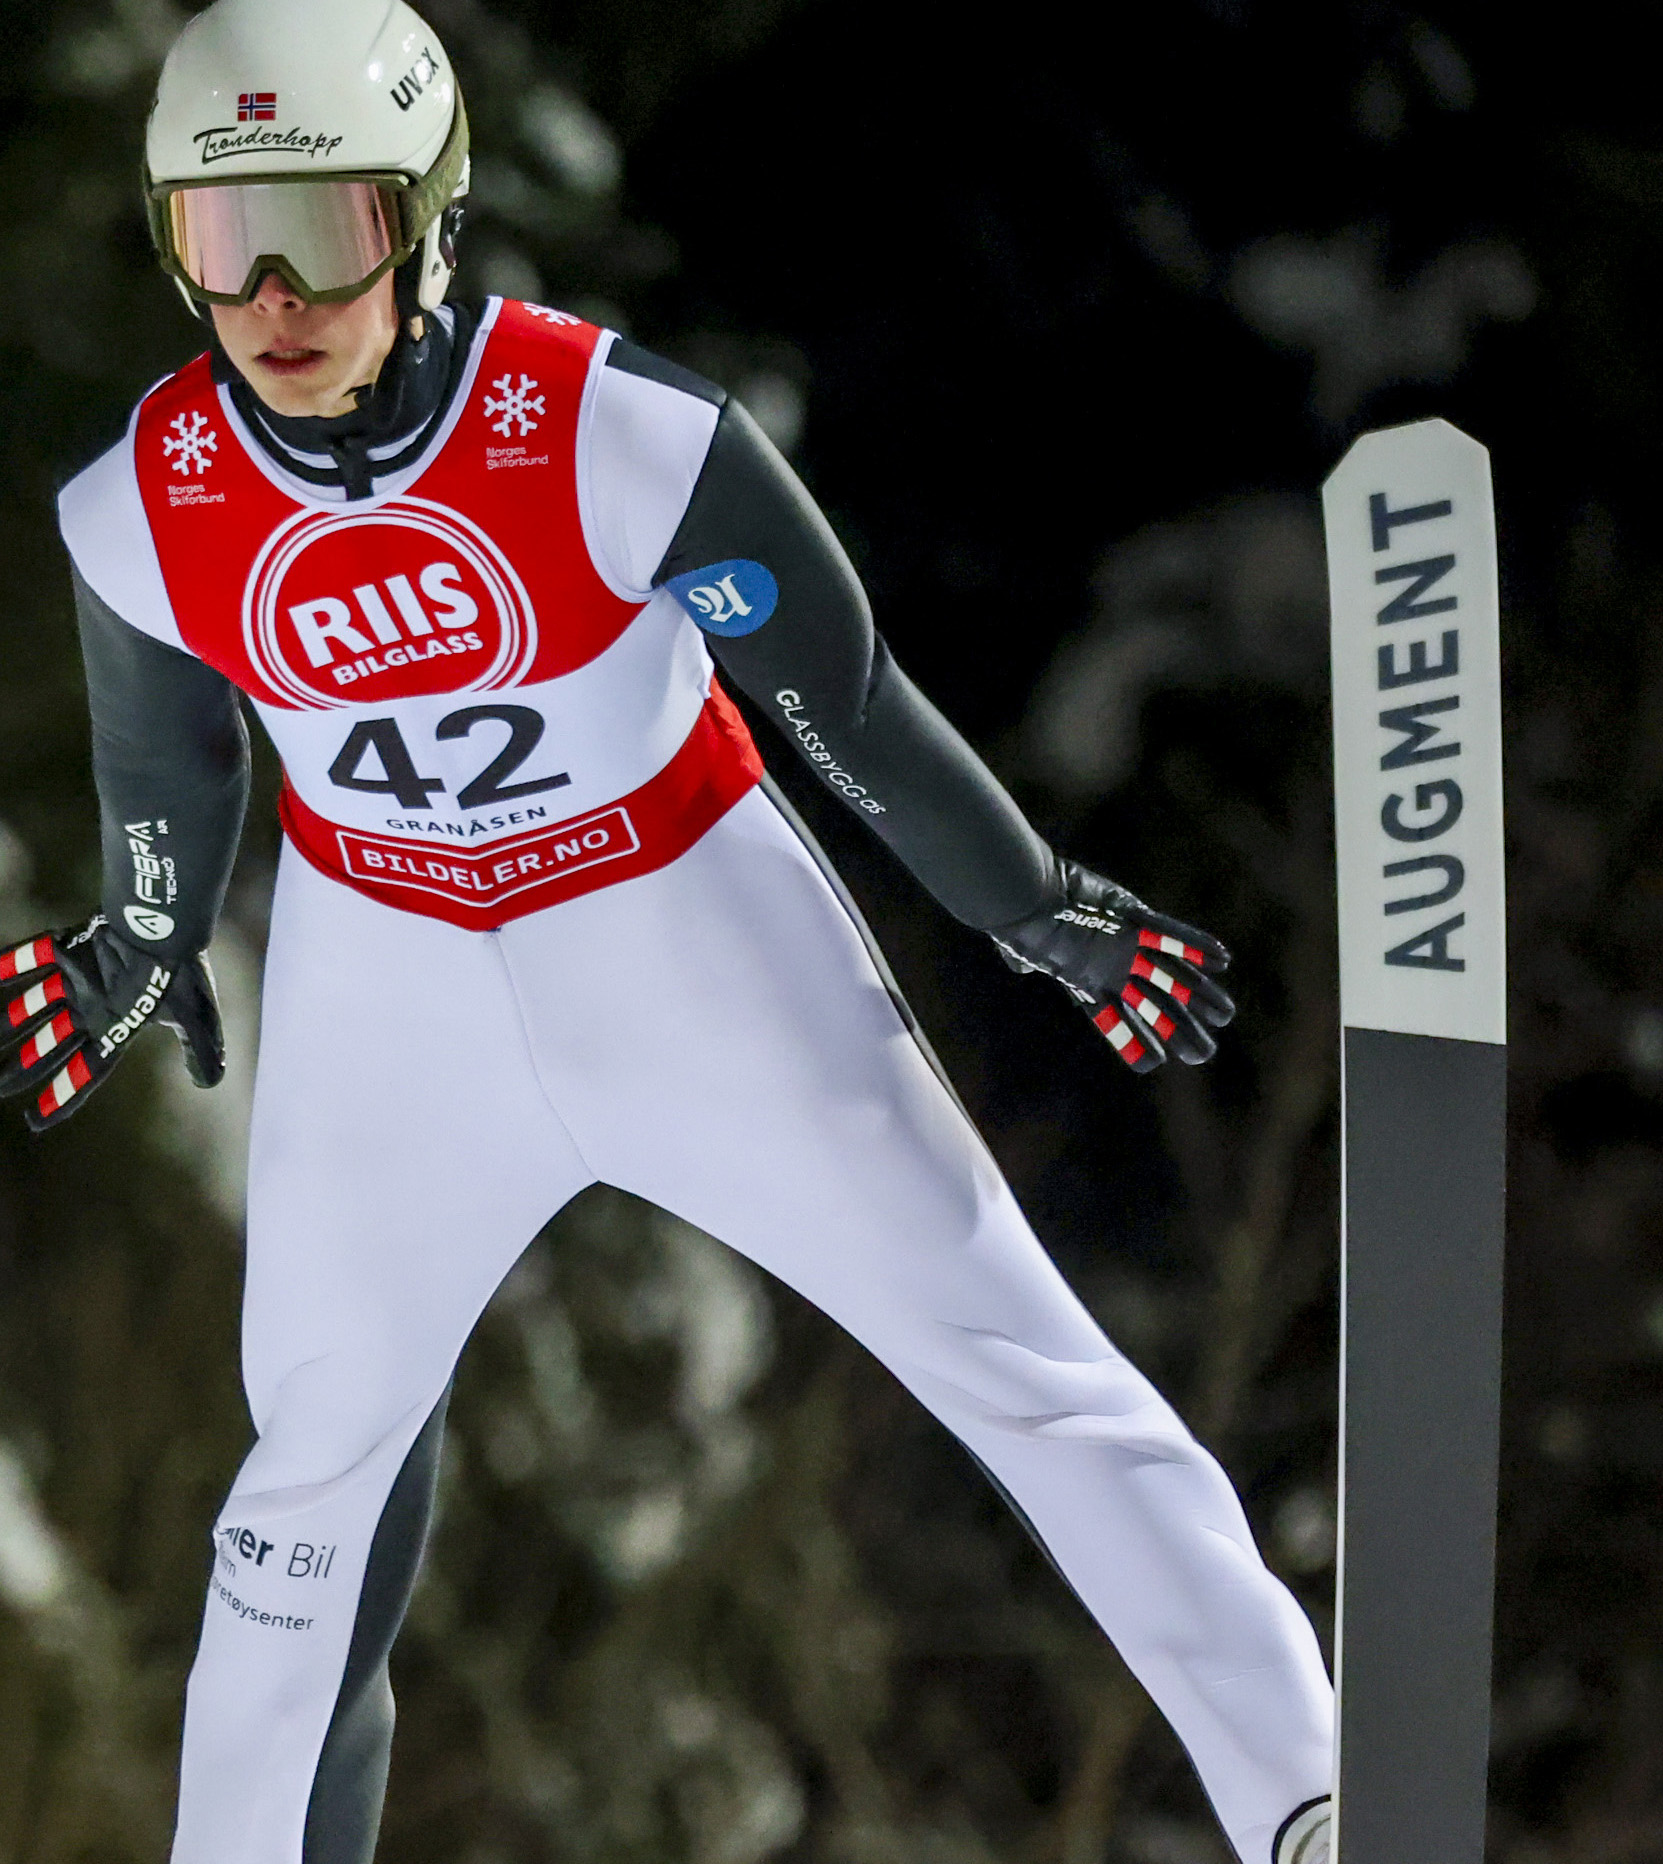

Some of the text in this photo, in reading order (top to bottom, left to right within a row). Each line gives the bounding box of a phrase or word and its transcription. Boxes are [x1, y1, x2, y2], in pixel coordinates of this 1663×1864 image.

[486, 446, 527, 460] Norges
[486, 454, 550, 470] Skiforbund
[167, 484, 206, 497] Norges
[169, 492, 226, 508] Skiforbund
[287, 561, 480, 670] RIIS
[331, 630, 485, 686] BILGLASS
[776, 689, 867, 798] GLASSBYGG
[1368, 491, 1466, 973] AUGMENT
[326, 703, 573, 811] 42
[385, 805, 547, 837] GRANÅSEN
[360, 827, 611, 891] BILDELER.NO
[1053, 909, 1122, 936] ziener
[99, 965, 171, 1058] ziener
[287, 1543, 337, 1579] Bil
